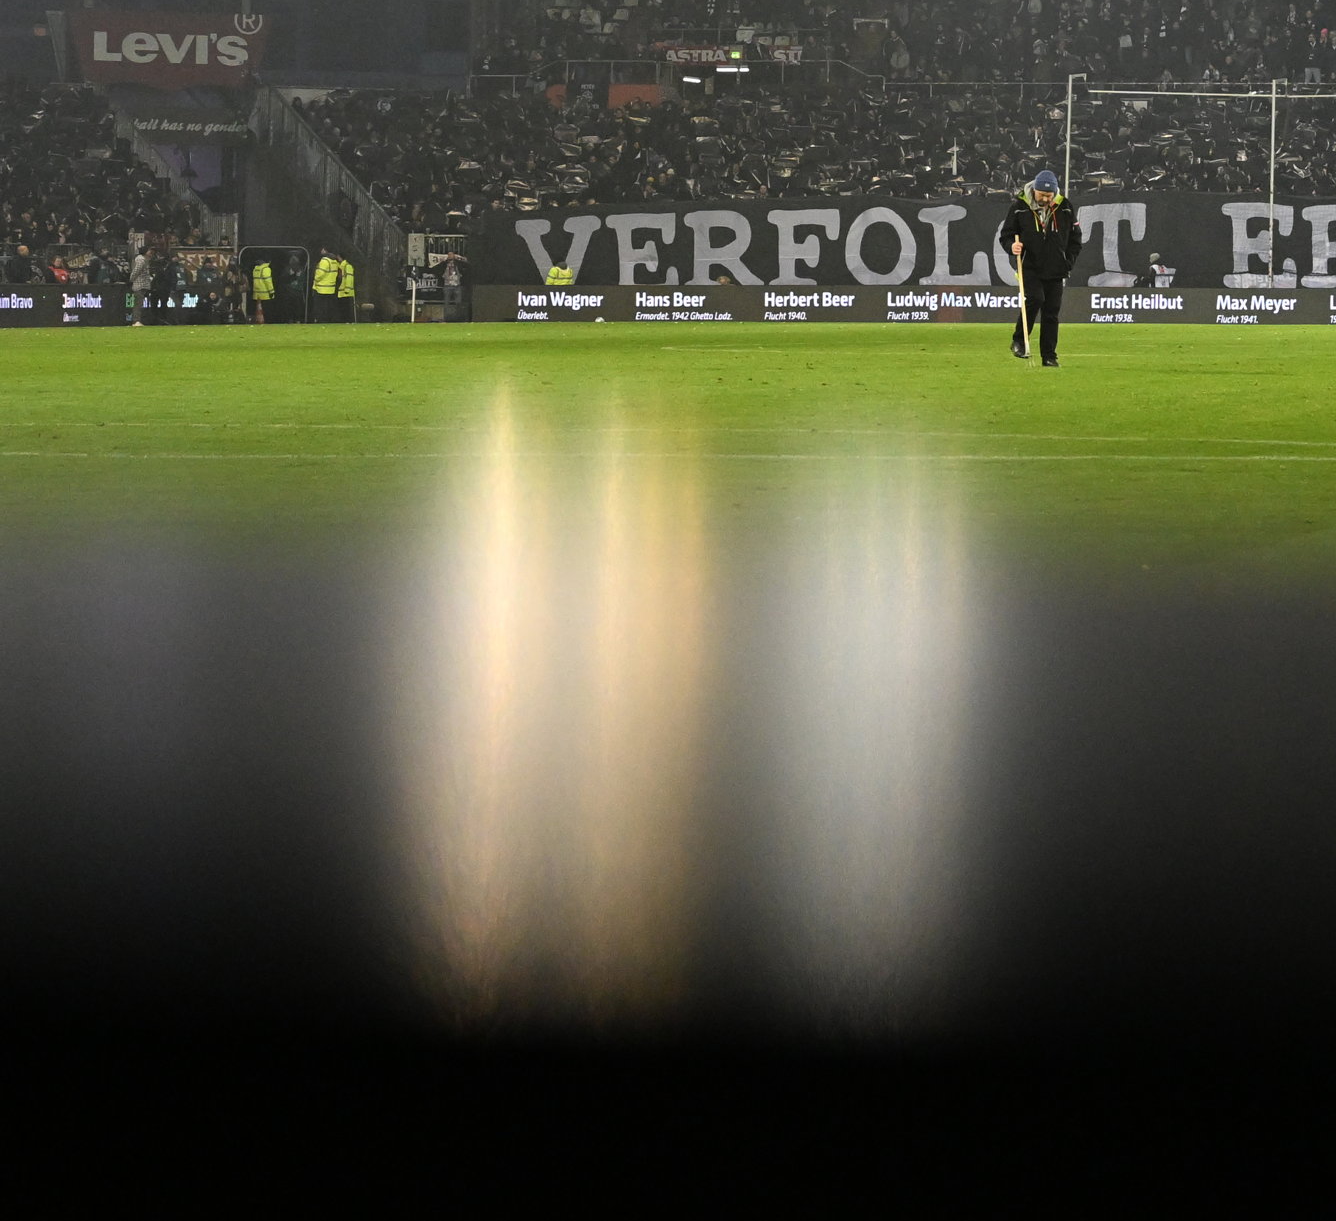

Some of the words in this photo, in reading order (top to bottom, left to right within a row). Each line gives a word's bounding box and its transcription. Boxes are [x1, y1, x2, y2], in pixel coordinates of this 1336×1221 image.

[666, 48, 728, 63] ASTRA
[515, 202, 1146, 285] VERFOLT
[11, 294, 33, 308] Bravo
[62, 294, 75, 308] Jan
[77, 293, 101, 308] Heilbut
[518, 292, 546, 306] Ivan
[550, 292, 603, 310] Wagner
[636, 292, 670, 307] Hans
[674, 292, 705, 307] Beer
[765, 292, 819, 307] Herbert
[822, 292, 855, 306] Beer
[888, 292, 938, 310] Ludwig
[941, 293, 971, 307] Max
[1091, 294, 1129, 309] Ernst
[1132, 294, 1183, 309] Heilbut
[1216, 295, 1247, 310] Max
[1251, 296, 1296, 313] Meyer
[518, 310, 548, 319] Überlebt.
[636, 312, 669, 320] Ermordet.
[672, 312, 689, 320] 1942
[690, 312, 713, 320] Ghetto
[715, 312, 732, 320] Lodz.
[765, 312, 786, 320] Flucht
[788, 312, 807, 320] 1940.
[911, 312, 929, 320] 1939.
[1091, 314, 1113, 322] Flucht
[1115, 314, 1133, 322] 1938.
[1216, 315, 1239, 323] Flucht
[1241, 315, 1258, 323] 1941.
